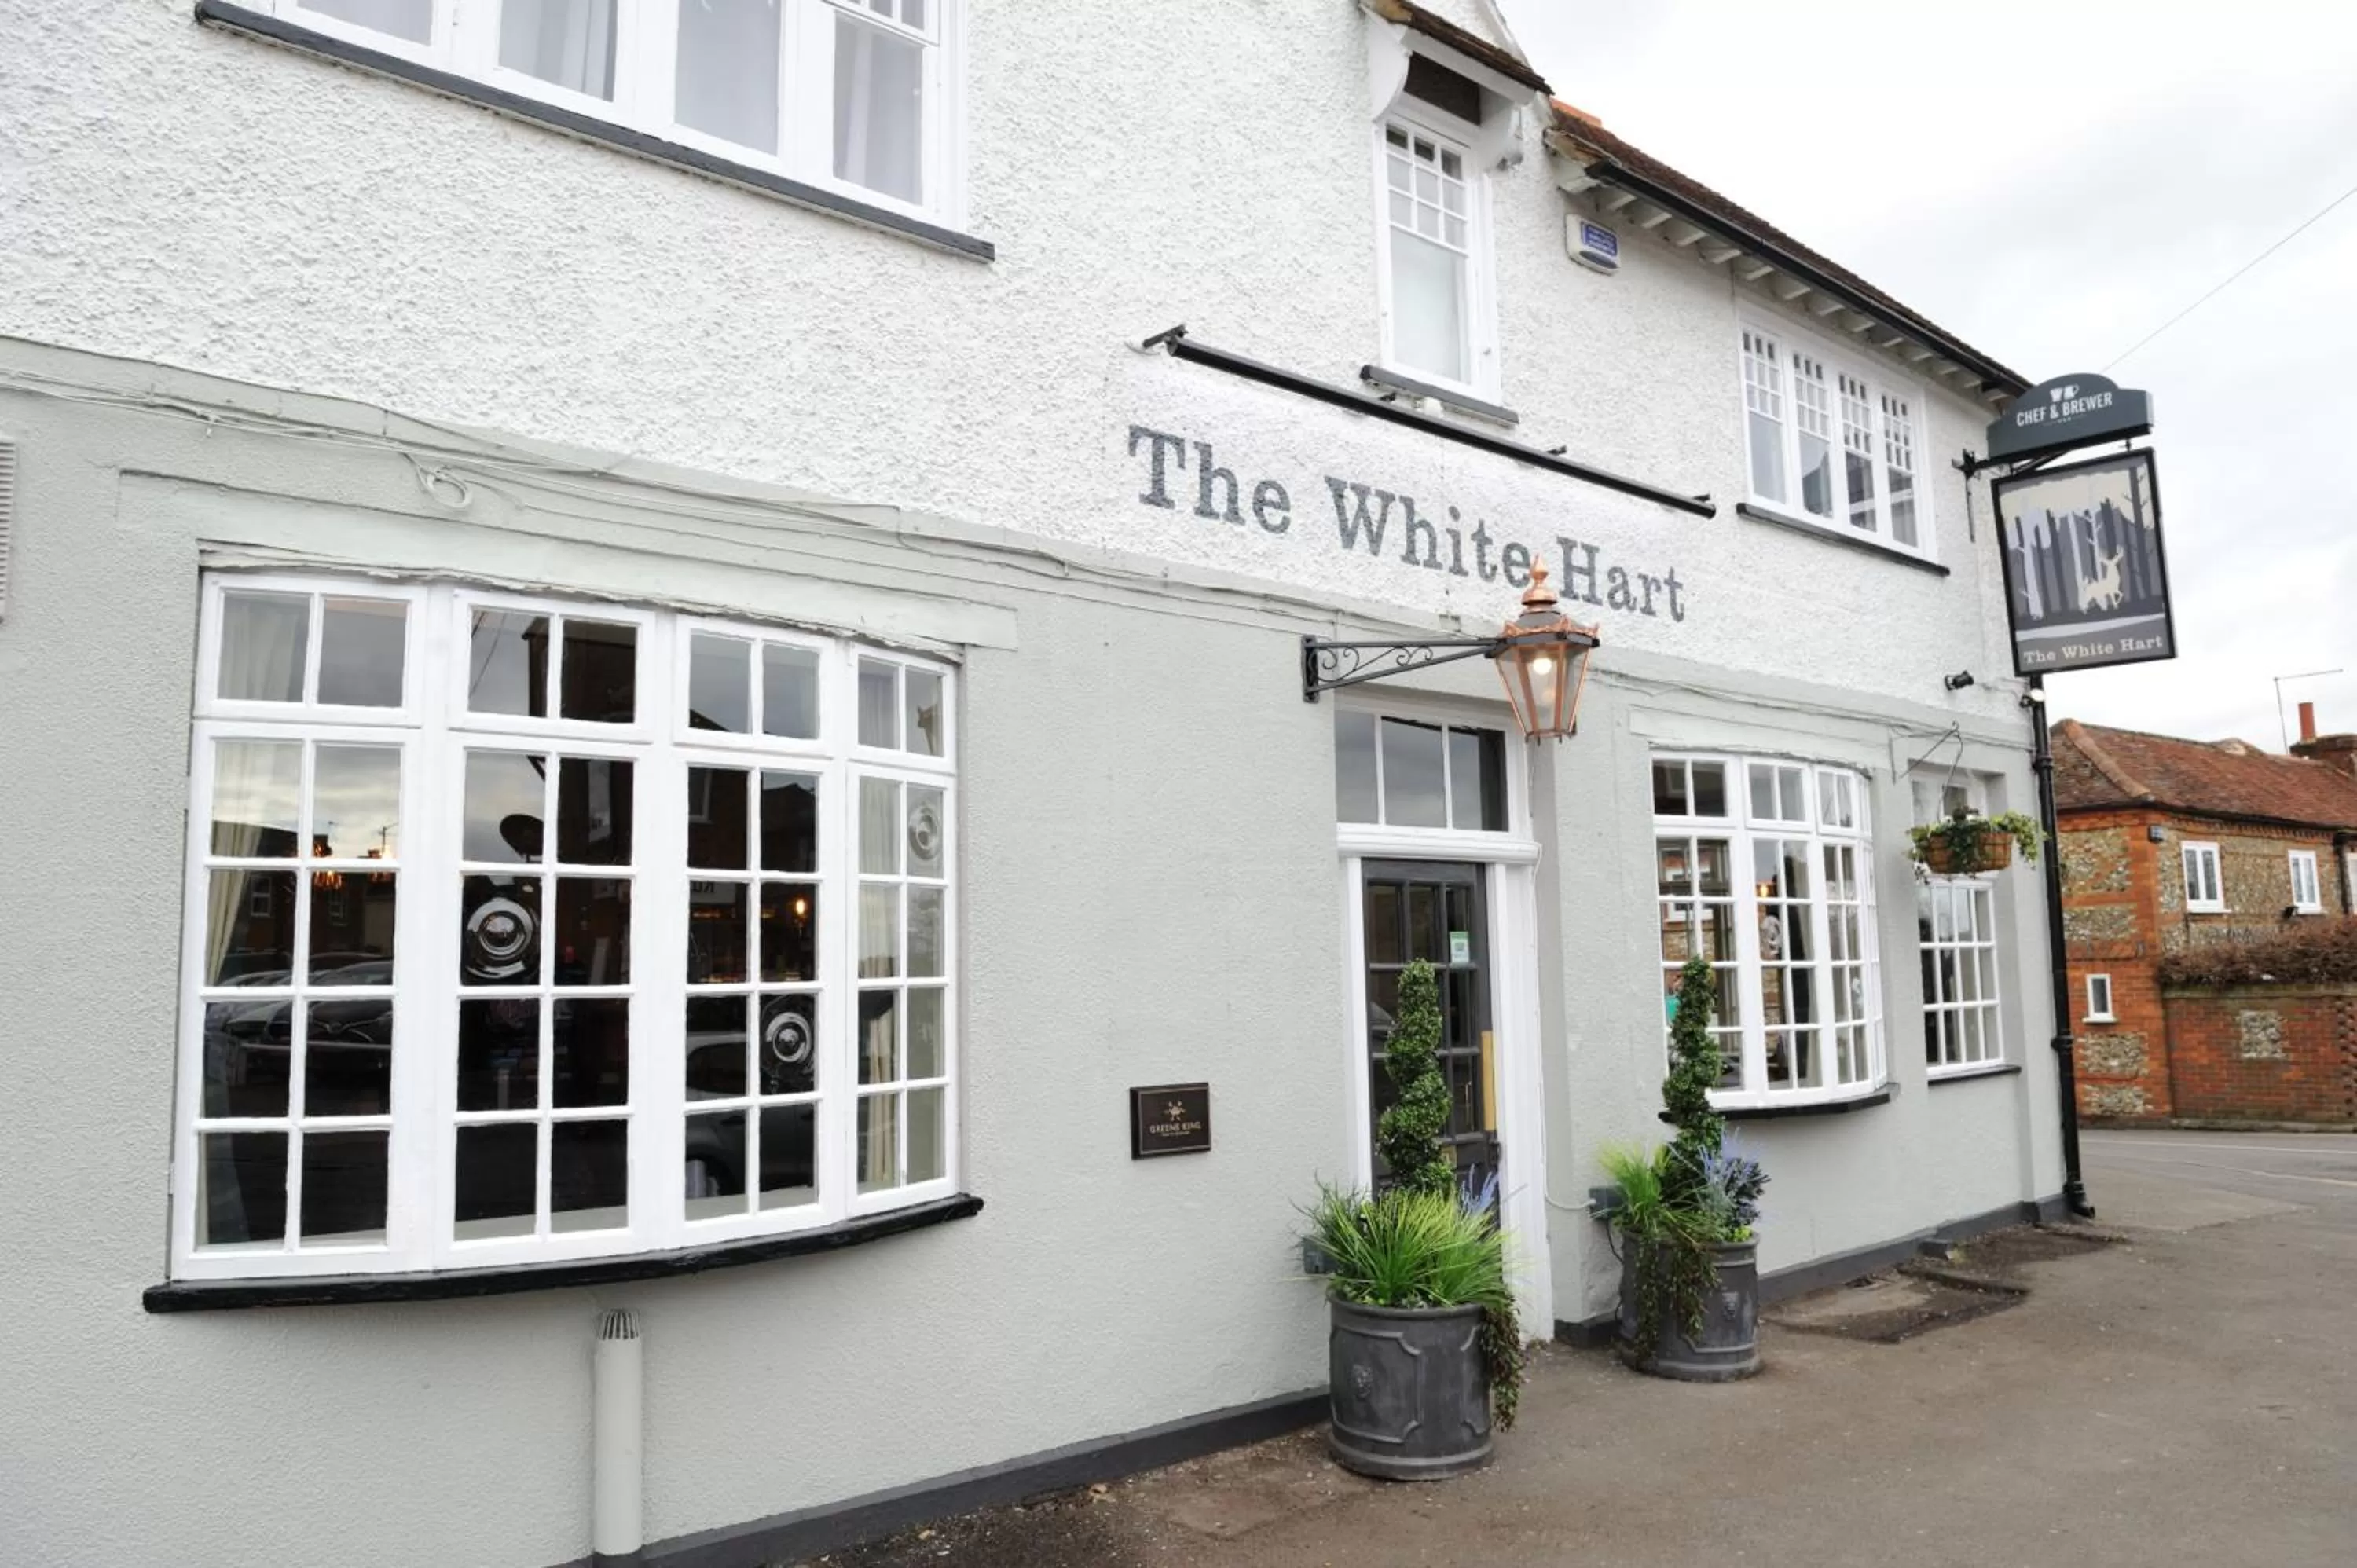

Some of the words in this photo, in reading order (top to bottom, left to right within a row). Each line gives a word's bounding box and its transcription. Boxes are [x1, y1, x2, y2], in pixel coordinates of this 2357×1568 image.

[2016, 406, 2047, 427] CHEF
[2049, 404, 2059, 419] &
[2062, 392, 2113, 416] BREWER
[1128, 424, 1292, 535] The
[1324, 475, 1530, 586] White
[1555, 535, 1686, 623] Hart
[2023, 650, 2056, 664] The
[2061, 643, 2115, 659] White
[2119, 635, 2163, 652] Hart
